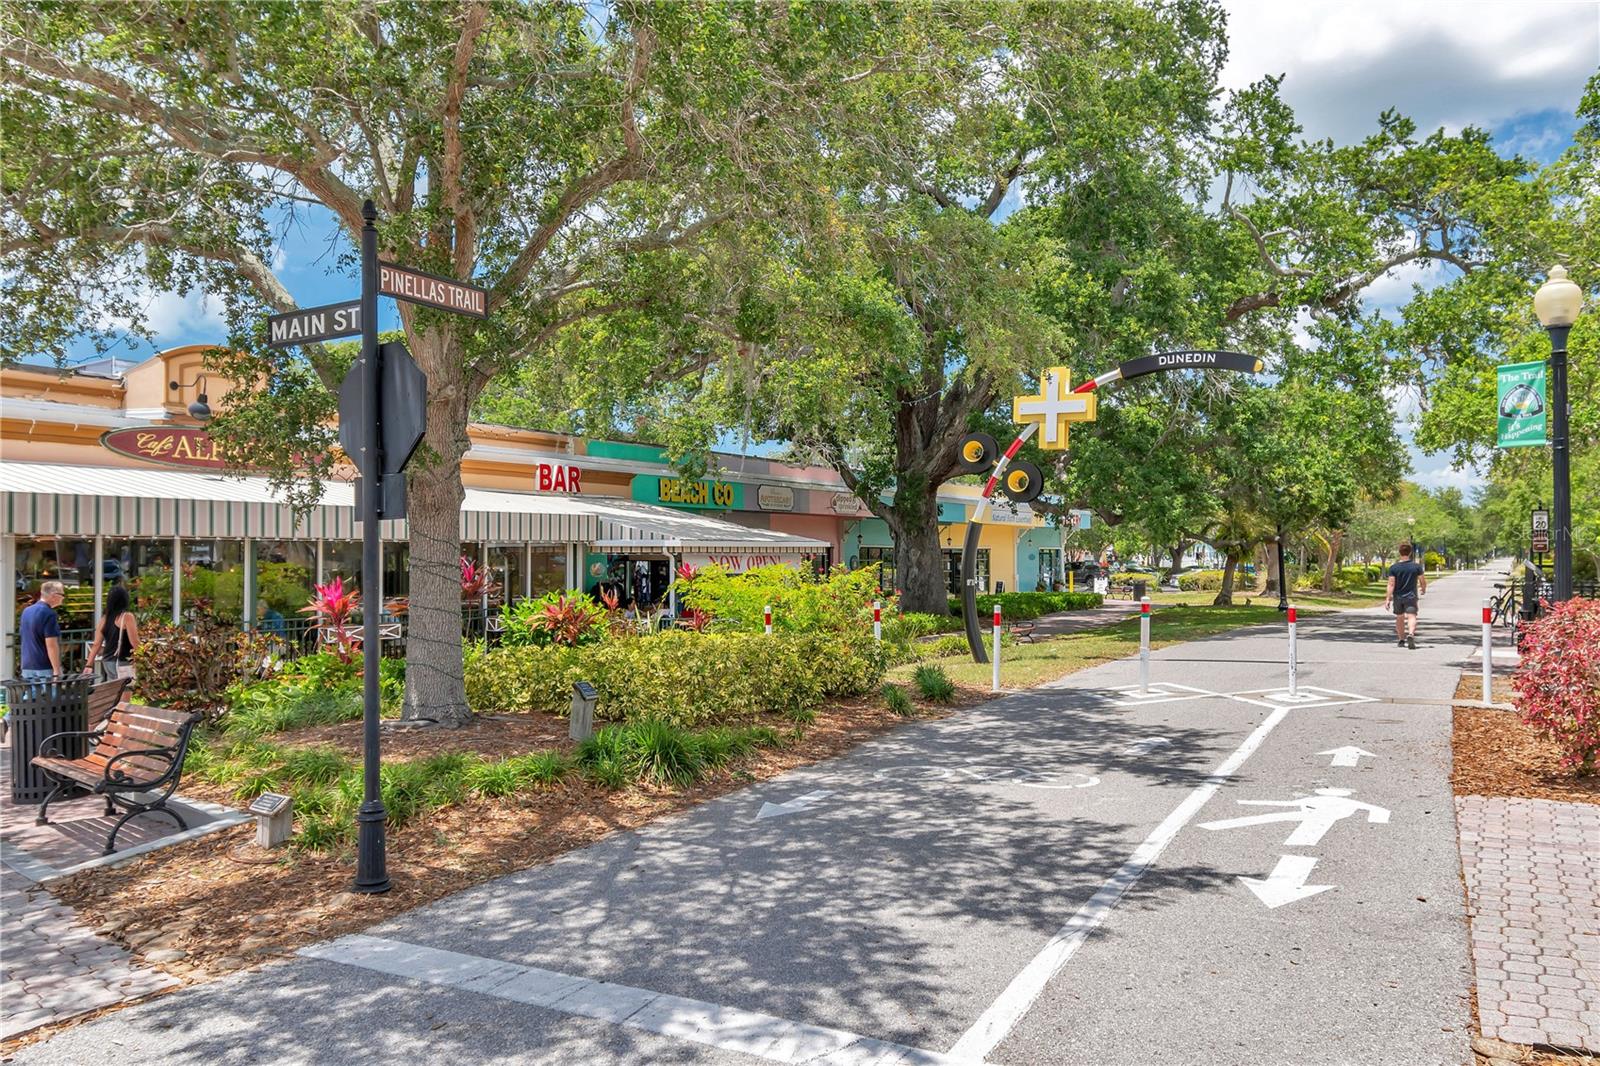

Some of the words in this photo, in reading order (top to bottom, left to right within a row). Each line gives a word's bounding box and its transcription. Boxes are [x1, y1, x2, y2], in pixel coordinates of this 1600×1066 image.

[380, 267, 445, 304] PINELLAS
[448, 286, 484, 313] TRAIL
[271, 313, 326, 342] MAIN
[333, 306, 361, 331] ST
[1158, 353, 1217, 366] DUNEDIN
[1501, 373, 1520, 383] The
[537, 463, 582, 493] BAR
[658, 478, 708, 505] BEACH
[713, 481, 734, 507] CO
[1535, 520, 1547, 529] 20
